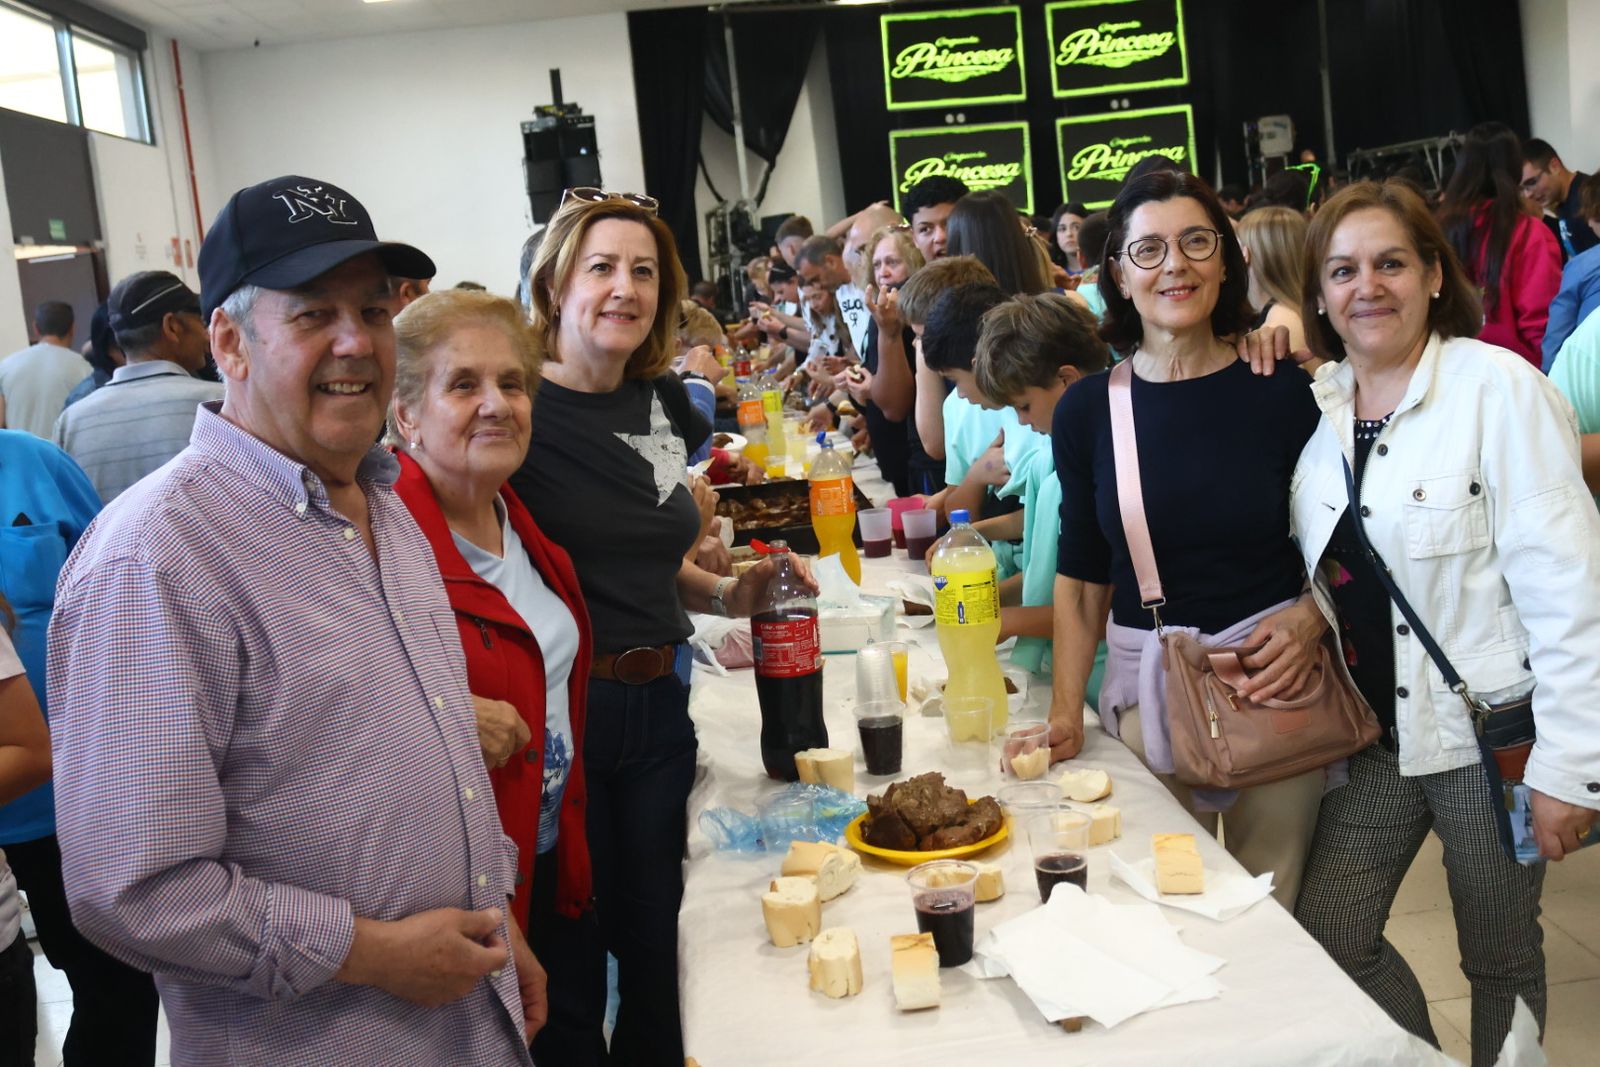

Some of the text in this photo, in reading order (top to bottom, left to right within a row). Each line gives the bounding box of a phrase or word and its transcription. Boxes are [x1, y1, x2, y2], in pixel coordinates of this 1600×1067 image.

[891, 42, 1015, 78] Princesa
[1056, 28, 1176, 66] Princesa
[272, 186, 358, 225] NY
